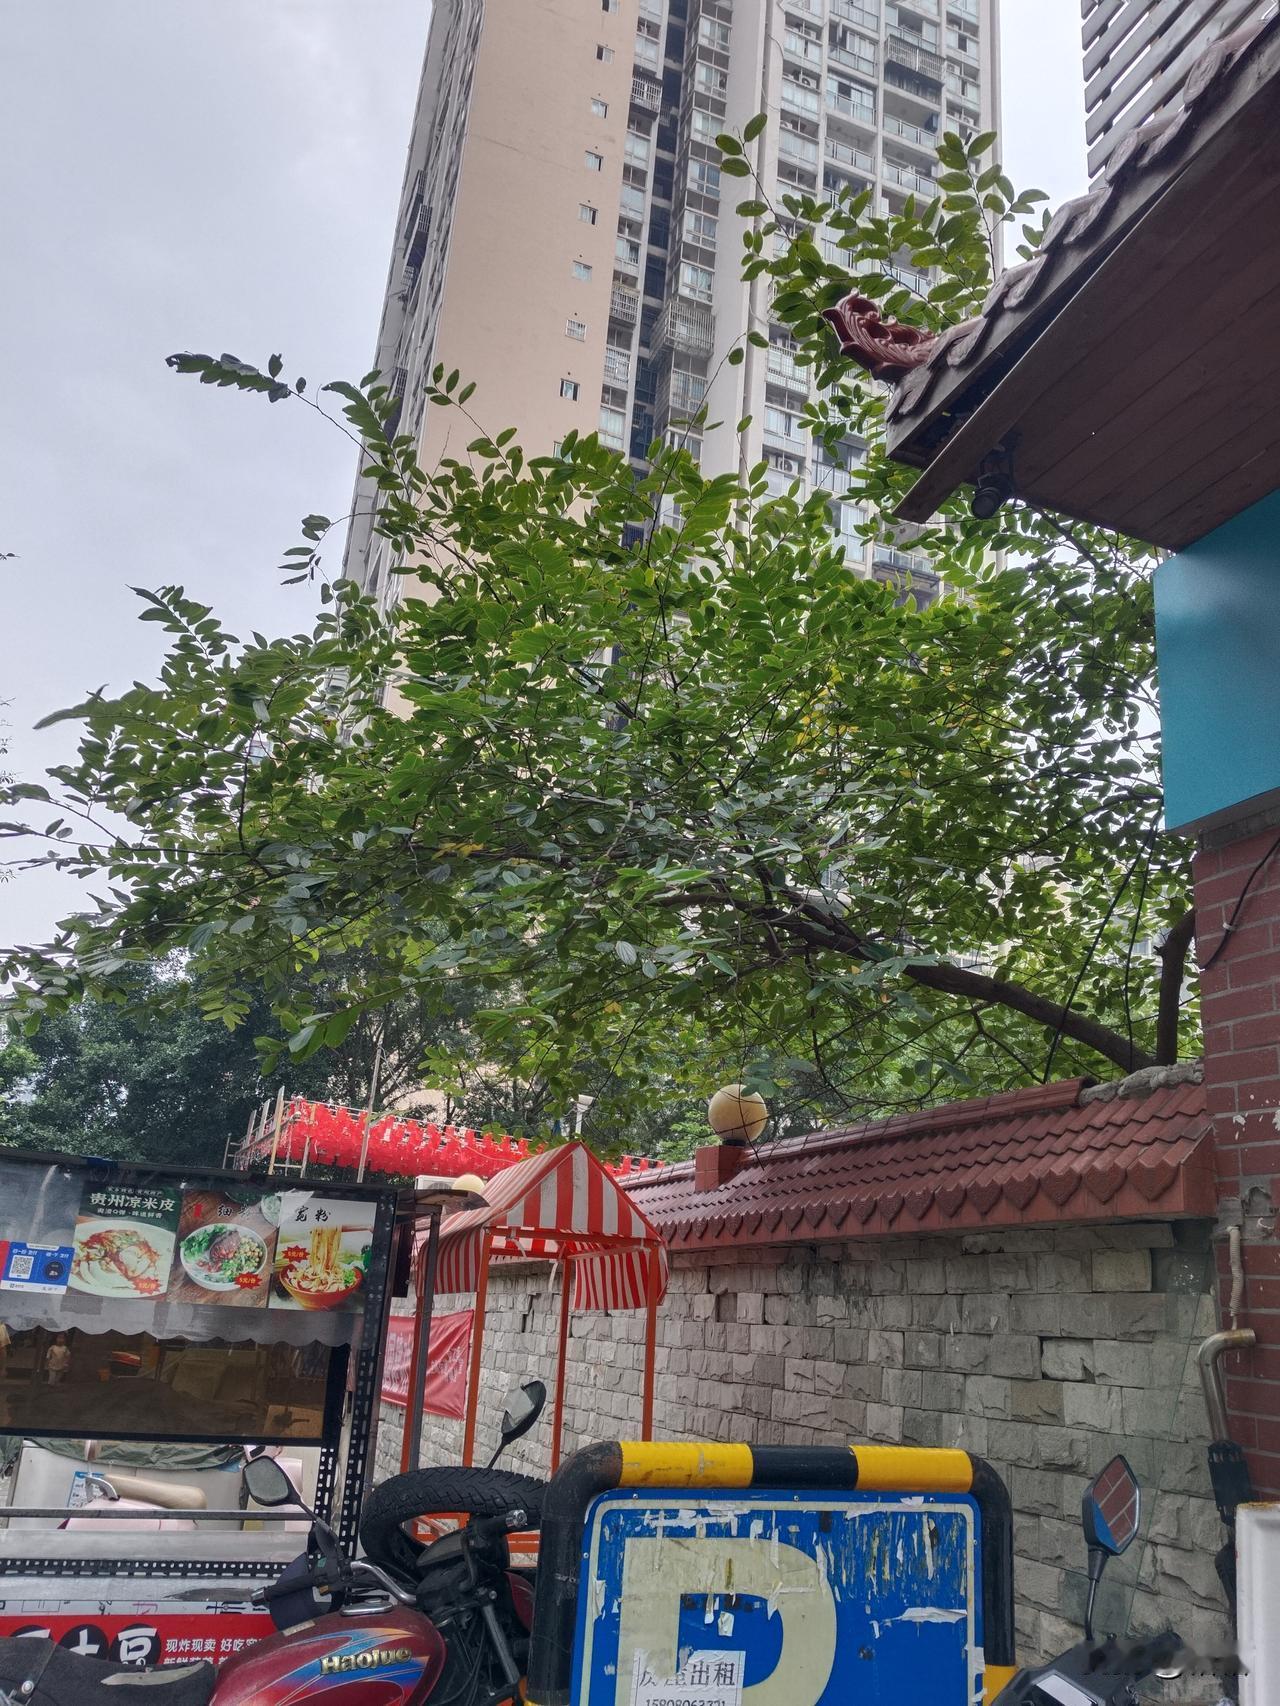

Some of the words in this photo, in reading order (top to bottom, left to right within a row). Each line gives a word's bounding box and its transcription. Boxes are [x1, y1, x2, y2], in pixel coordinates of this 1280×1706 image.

[90, 1192, 176, 1212] 贵州凉米皮
[166, 1638, 216, 1653] 现炸现卖
[321, 1648, 412, 1675] Haojue
